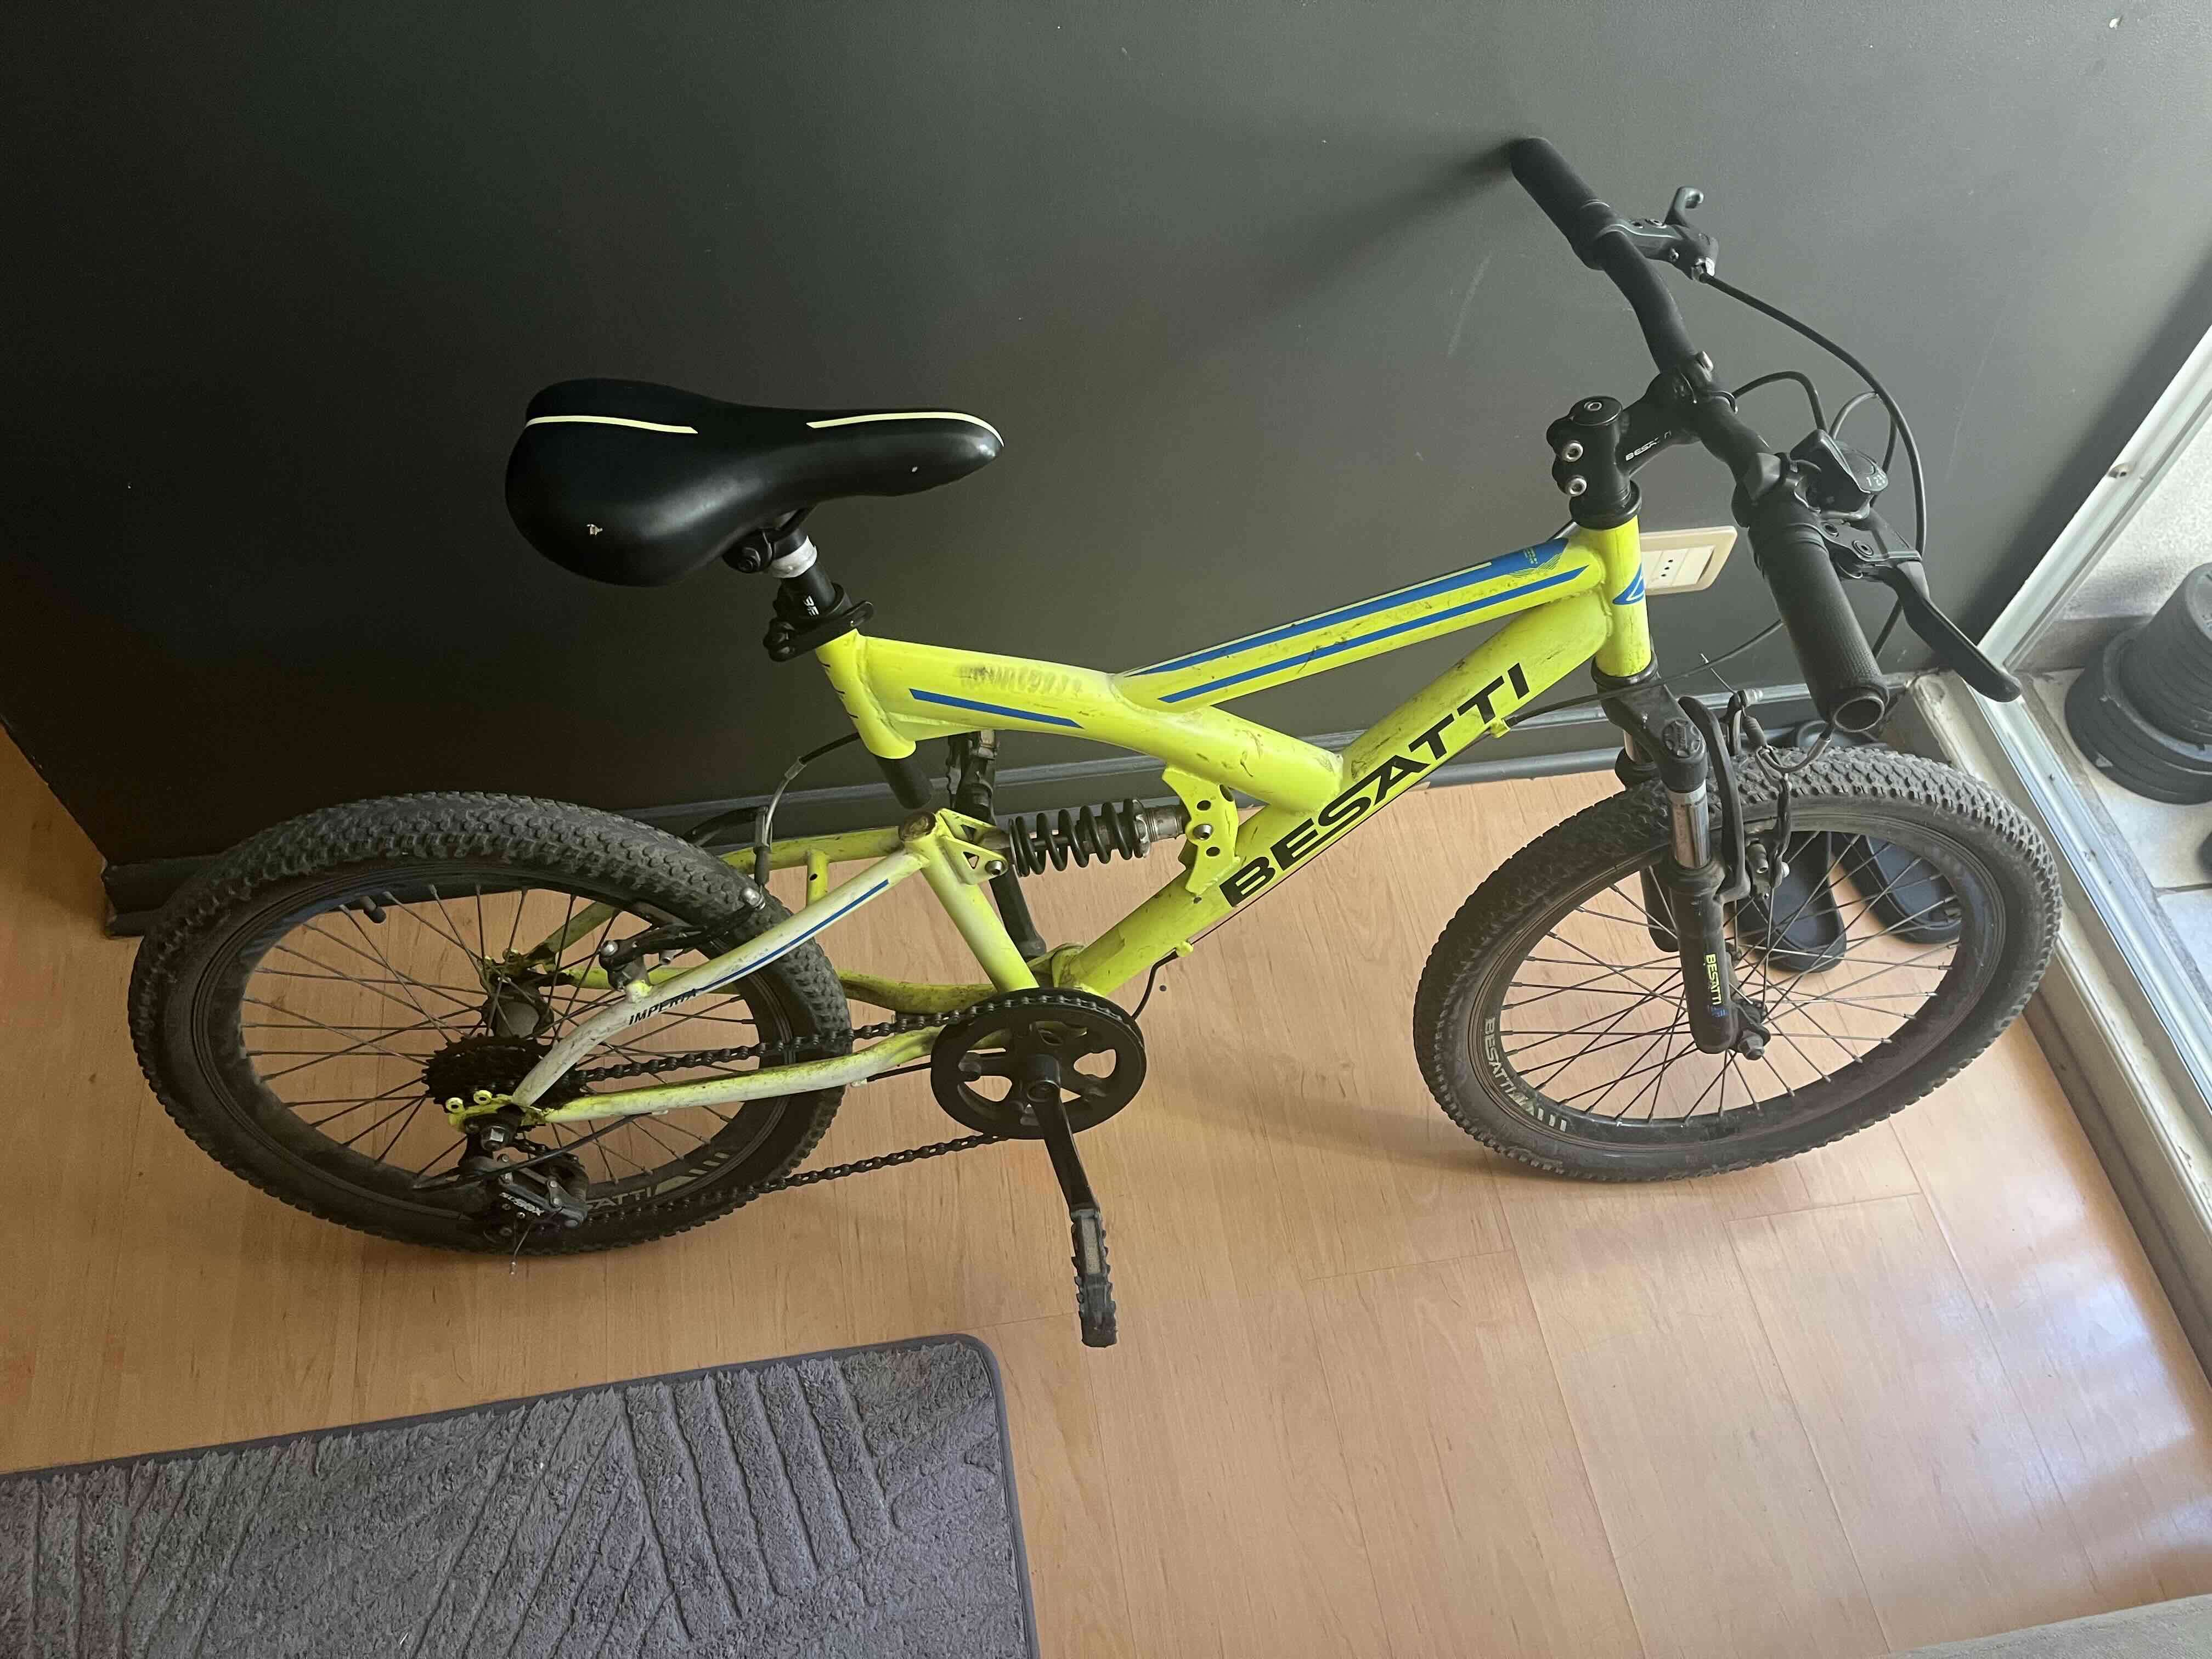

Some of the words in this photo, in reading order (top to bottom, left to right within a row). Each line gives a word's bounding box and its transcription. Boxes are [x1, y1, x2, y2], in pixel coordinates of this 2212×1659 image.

[1219, 662, 1530, 907] BESATTI
[1706, 953, 1722, 1005] BESATTI
[1485, 1017, 1517, 1093] BESATTI
